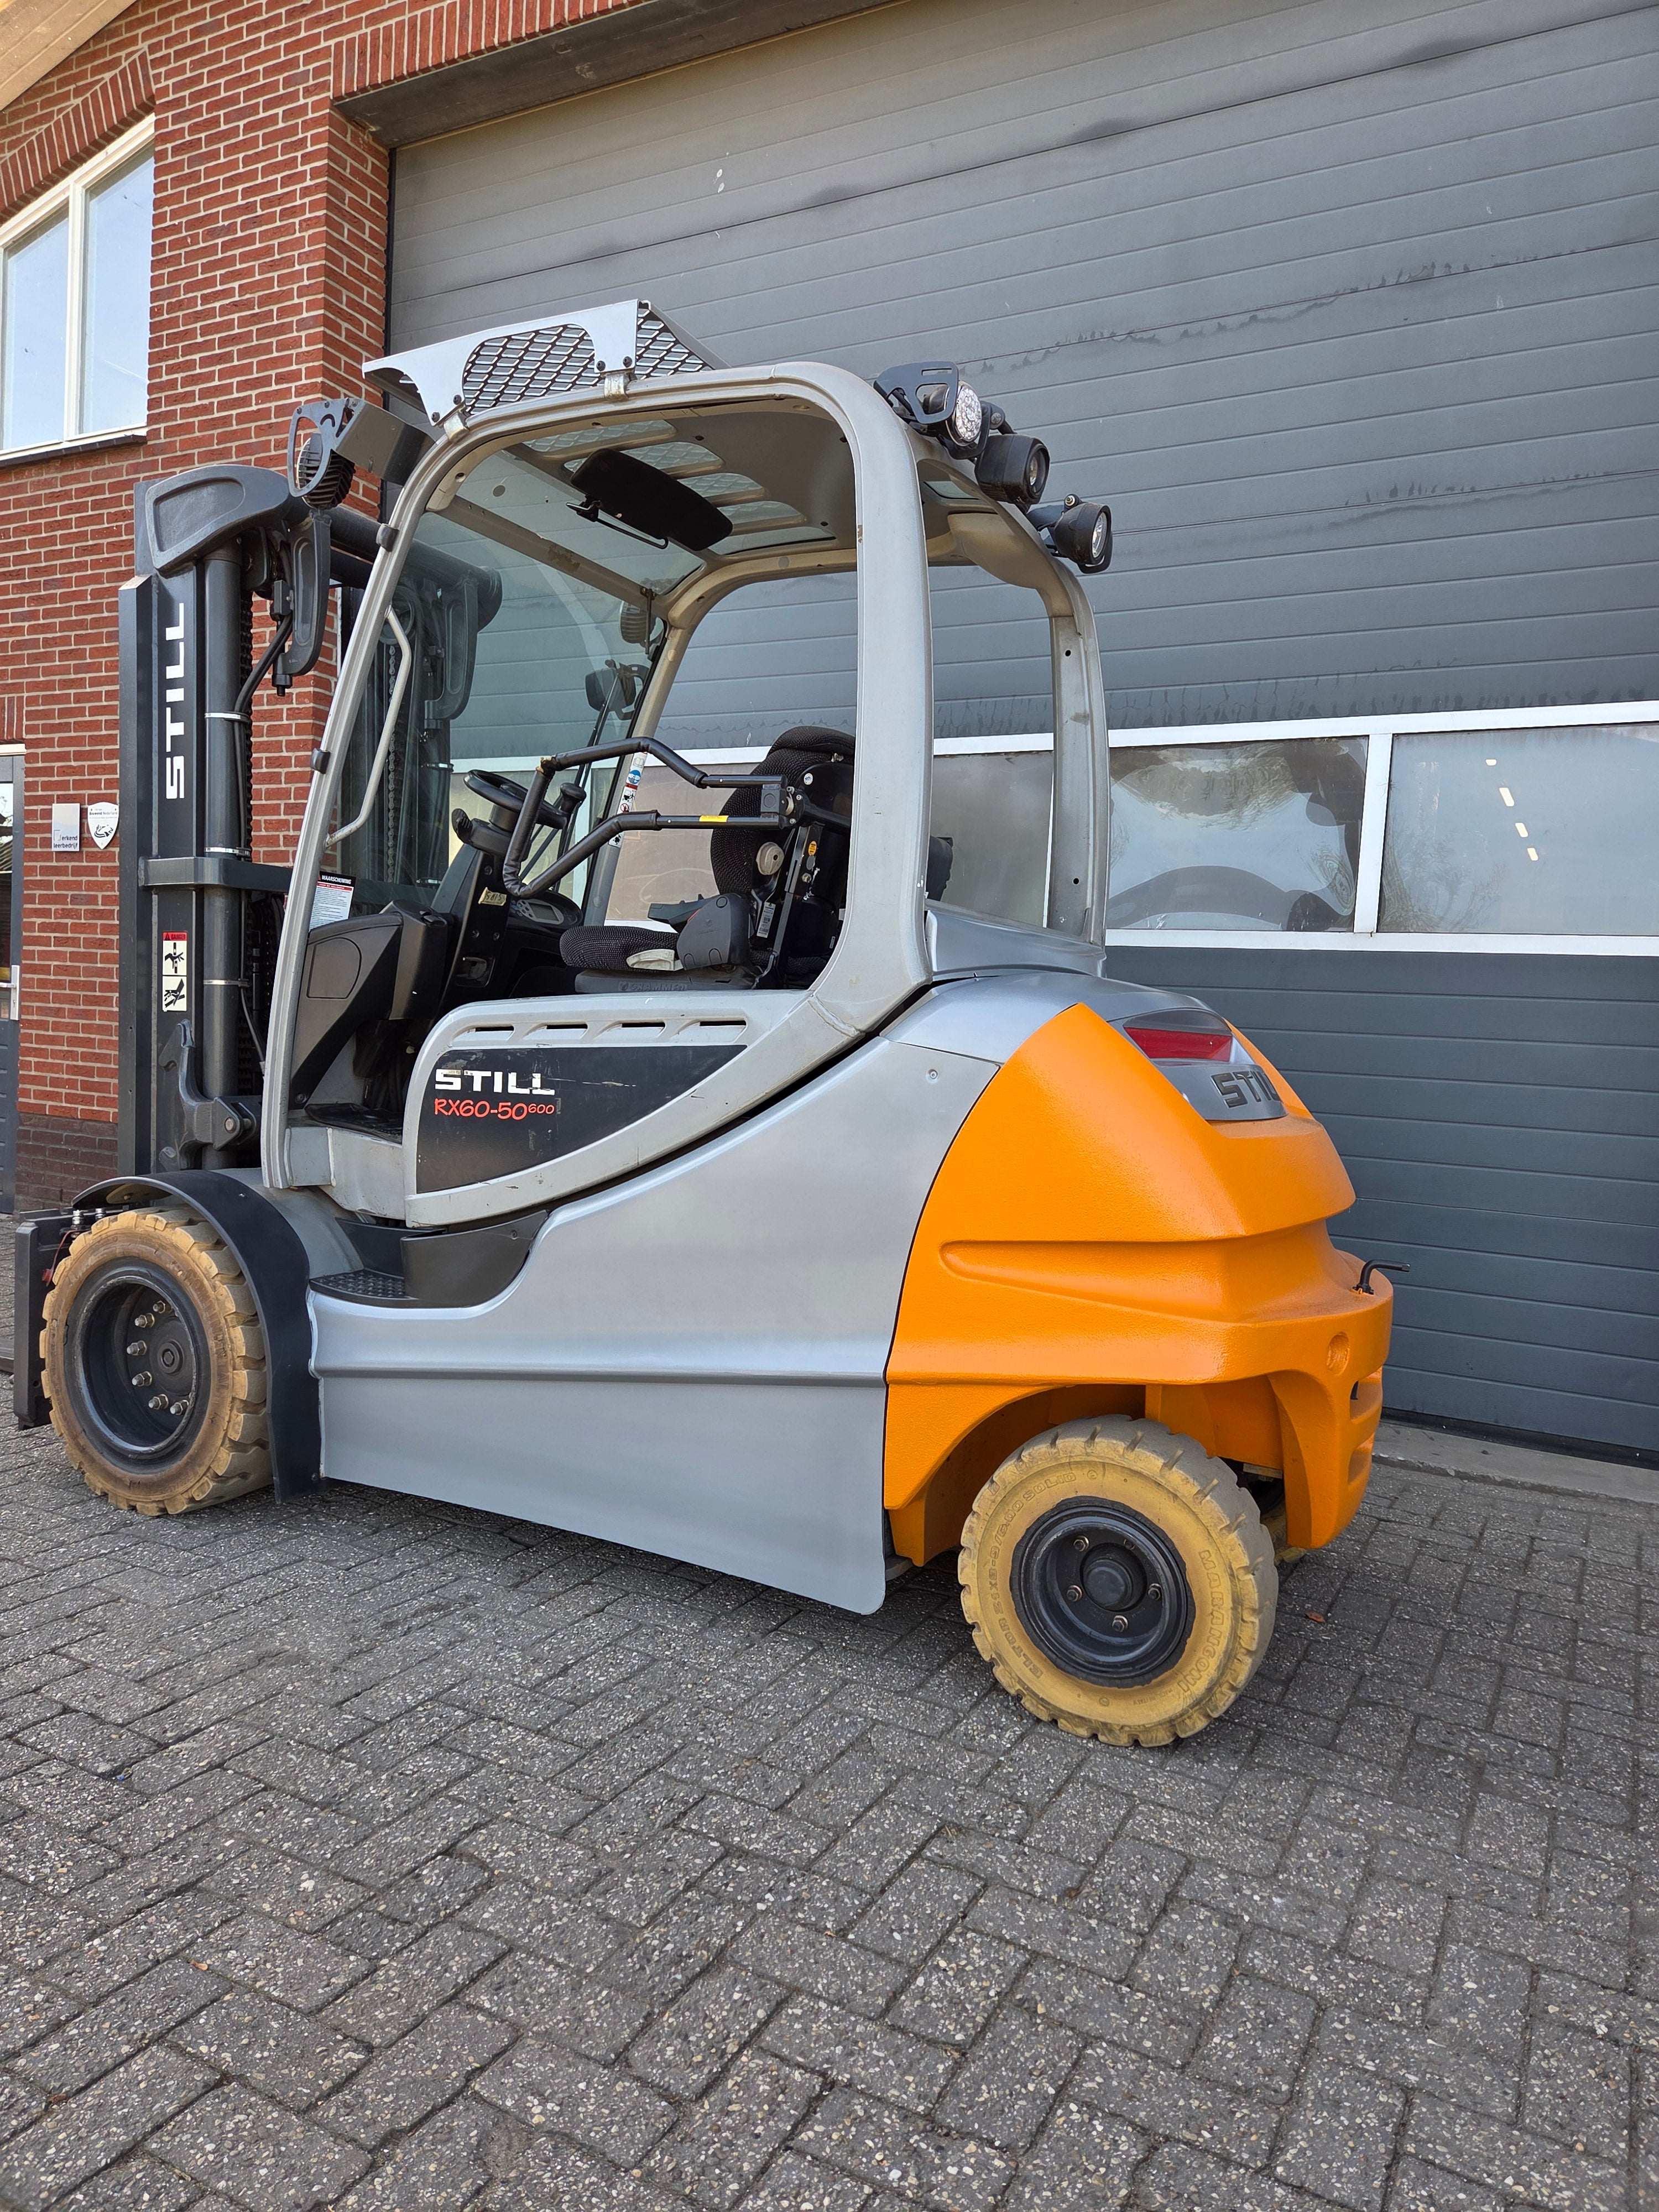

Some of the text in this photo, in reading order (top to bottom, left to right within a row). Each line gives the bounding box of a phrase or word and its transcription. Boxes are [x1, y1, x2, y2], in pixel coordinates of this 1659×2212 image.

[165, 602, 185, 799] STILL
[321, 875, 352, 885] WAARSCHUWING
[435, 1068, 555, 1095] STILL
[1023, 1472, 1077, 1502] SOLID
[1177, 1550, 1225, 1693] MARANGONI
